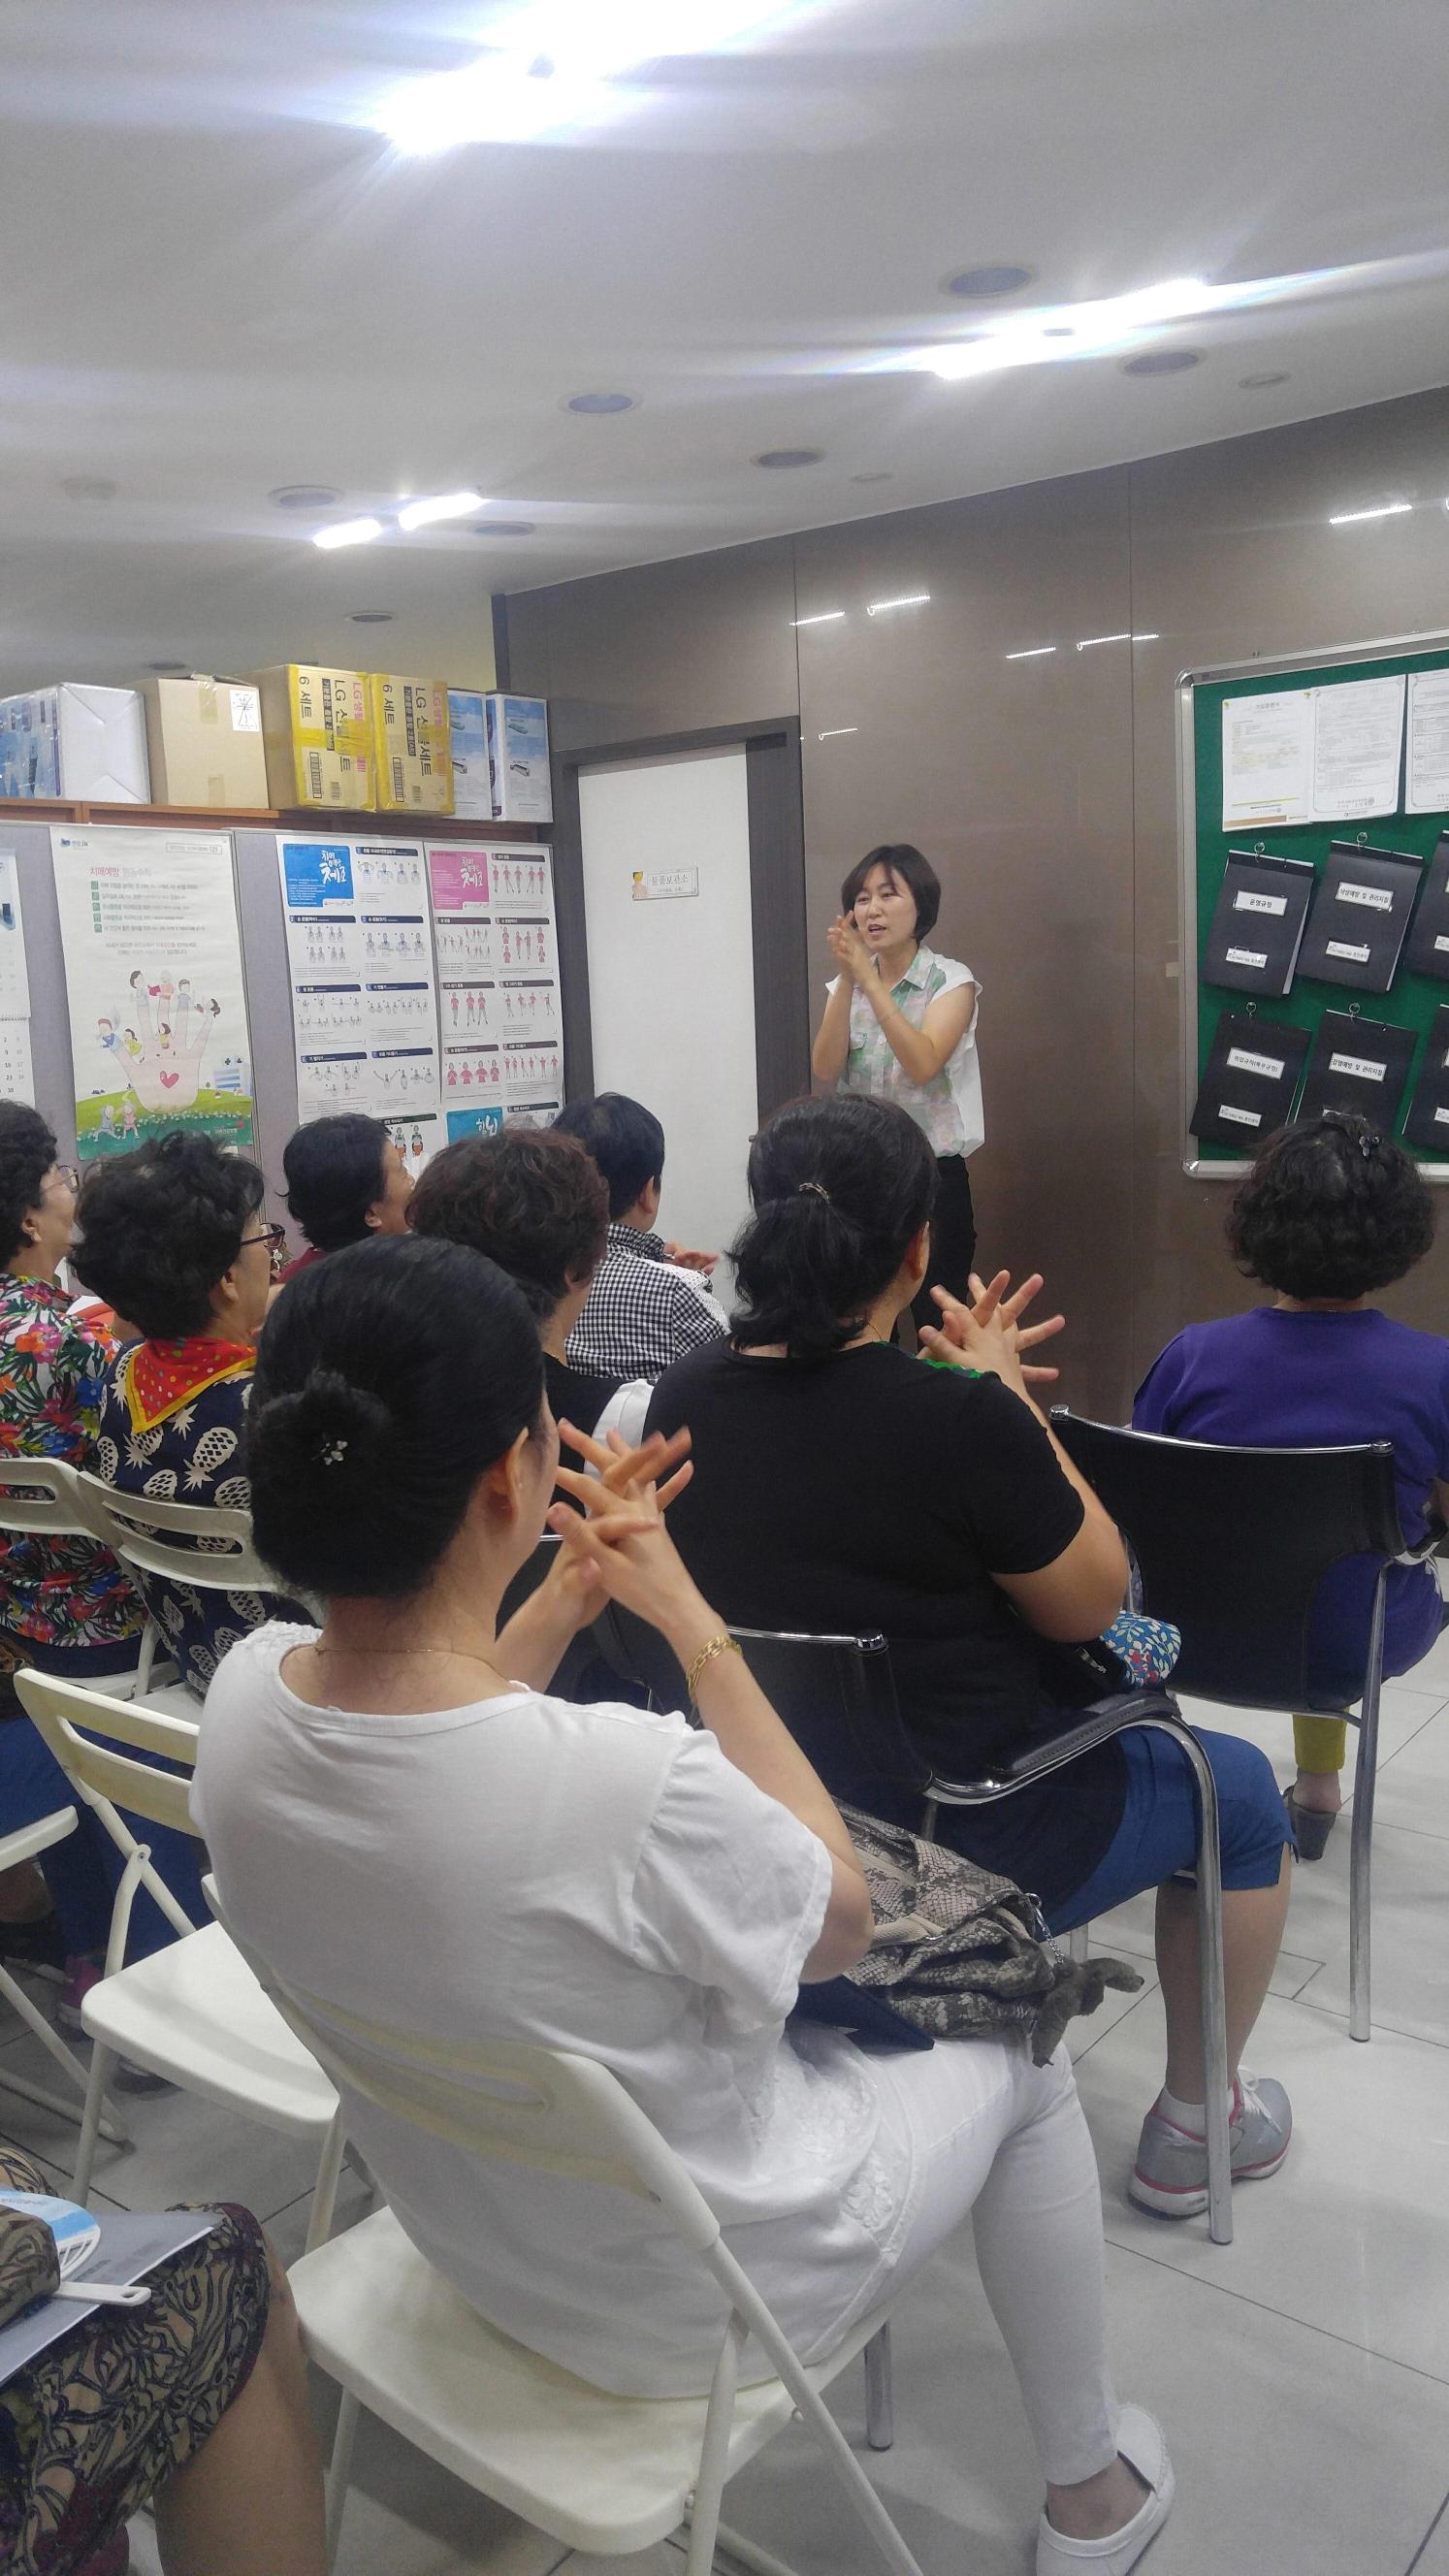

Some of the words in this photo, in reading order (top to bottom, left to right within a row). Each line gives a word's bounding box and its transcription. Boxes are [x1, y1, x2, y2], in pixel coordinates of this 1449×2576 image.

[300, 676, 309, 686] 6
[335, 680, 346, 701] LG
[382, 685, 393, 693] 6
[300, 692, 311, 719] 세트
[415, 688, 426, 709] LG
[384, 698, 395, 724] 세트
[1249, 898, 1272, 909] 운영규정
